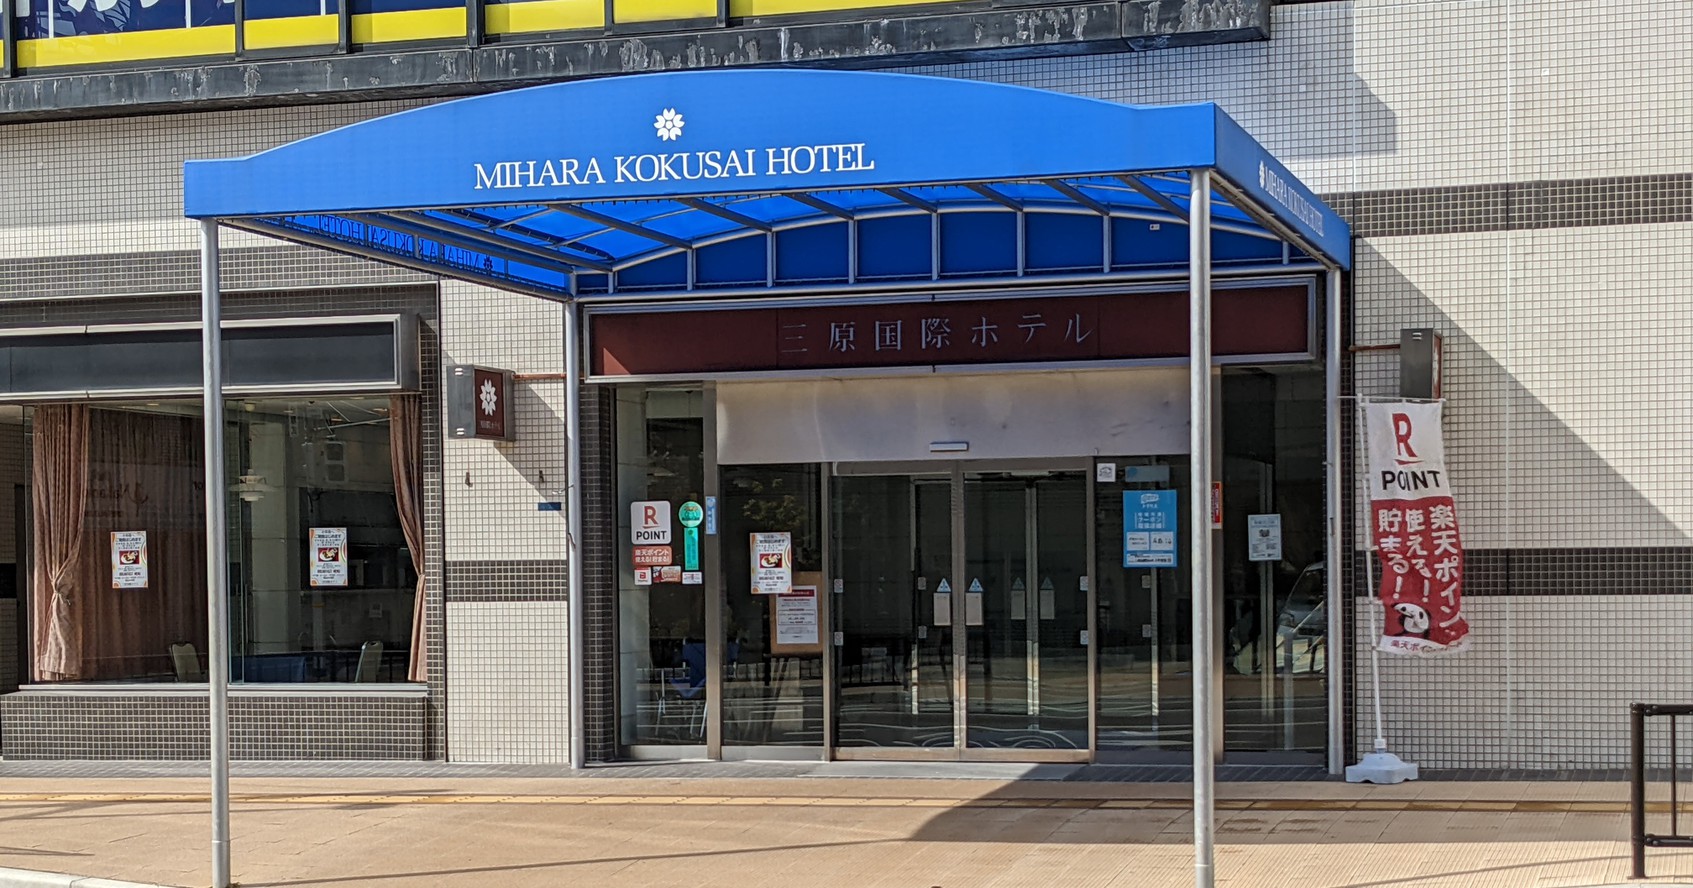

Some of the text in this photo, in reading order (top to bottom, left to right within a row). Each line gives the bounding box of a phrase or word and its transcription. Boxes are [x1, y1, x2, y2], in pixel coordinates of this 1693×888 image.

[474, 143, 874, 190] MIHARA KOKUSAI HOTEL
[1265, 166, 1287, 207] MIHARA
[781, 313, 1096, 354] 三原国際ホテル
[1392, 412, 1418, 458] R
[1381, 470, 1441, 491] POINT
[636, 530, 667, 541] POINT
[644, 505, 658, 525] R
[1378, 508, 1410, 600] 貯まる！
[1428, 505, 1462, 634] 楽天ポイン
